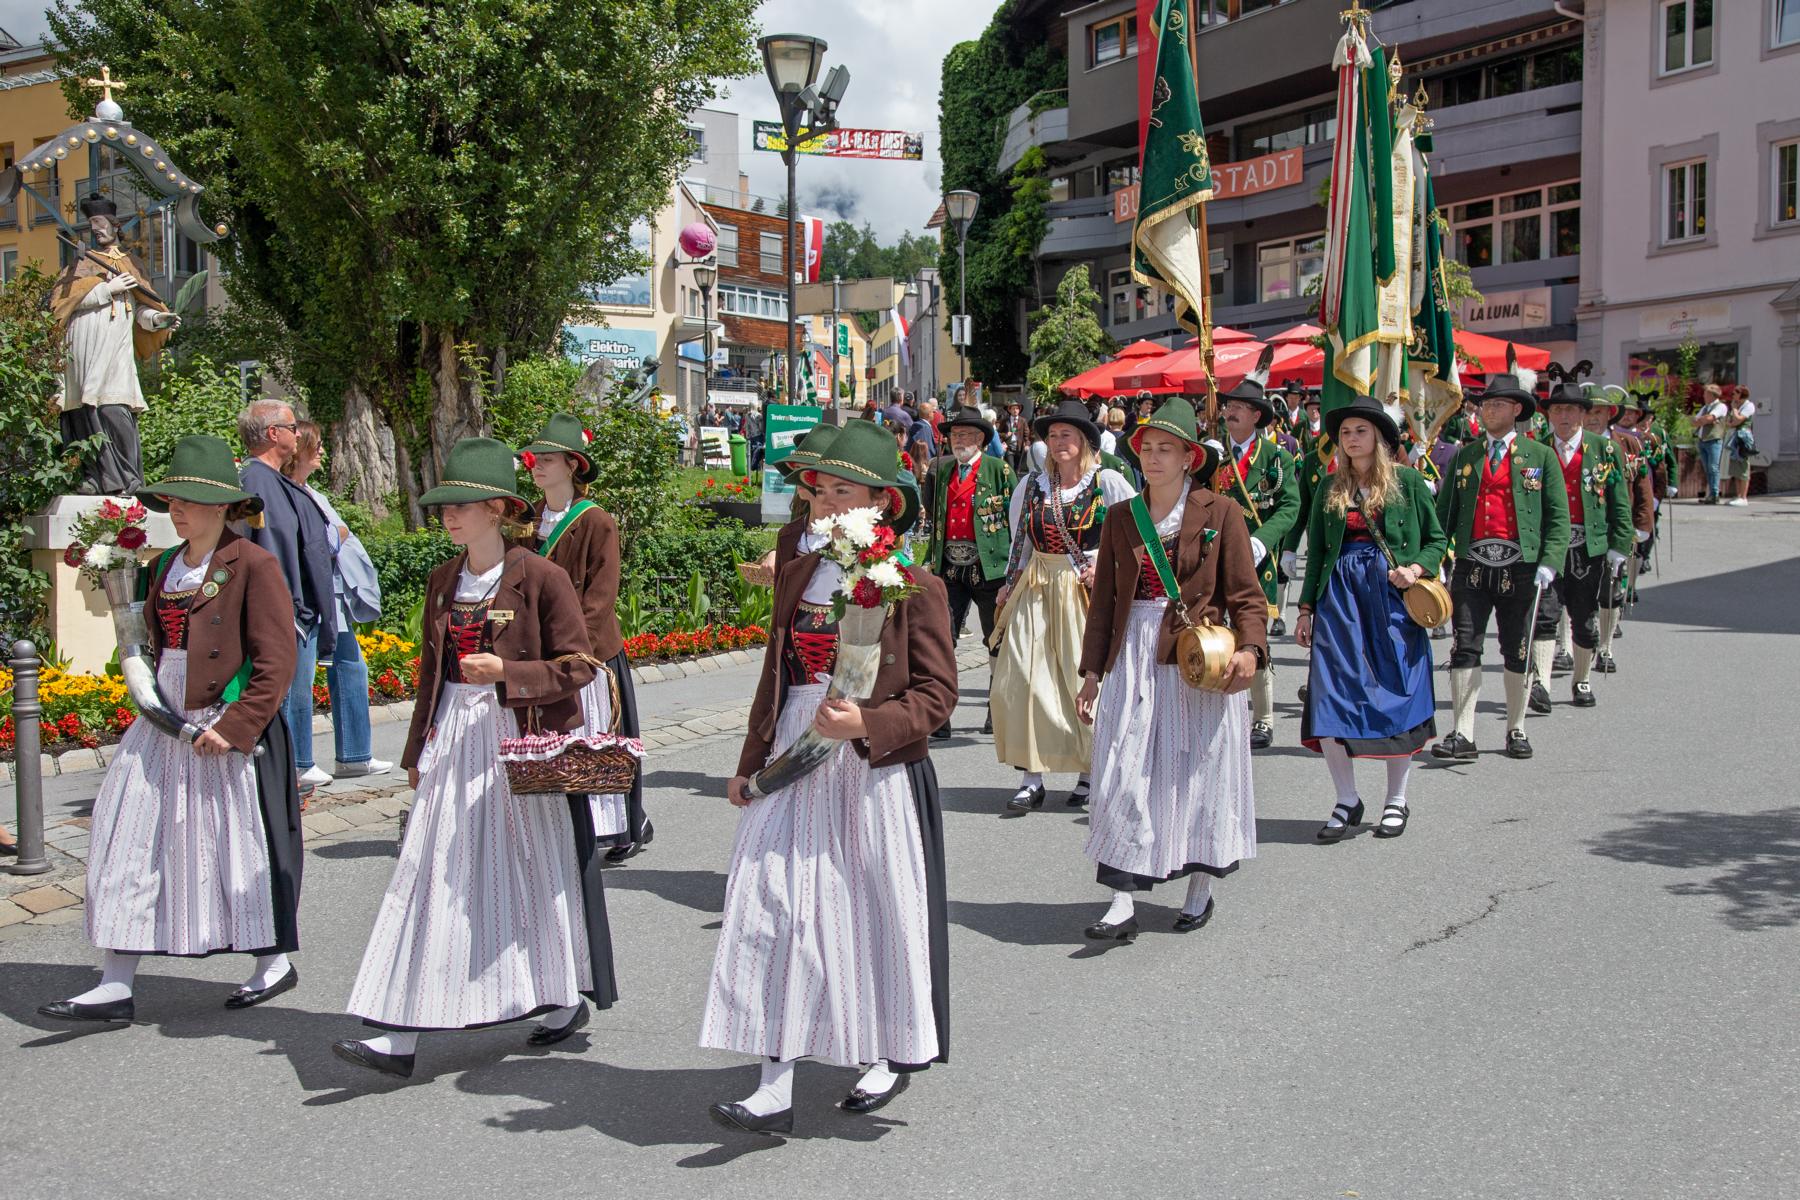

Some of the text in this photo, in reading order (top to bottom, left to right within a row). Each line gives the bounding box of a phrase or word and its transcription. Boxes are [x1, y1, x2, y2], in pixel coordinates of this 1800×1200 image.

[880, 132, 904, 149] IMST
[1470, 303, 1519, 321] LA LUNA
[590, 339, 635, 354] Elektro-
